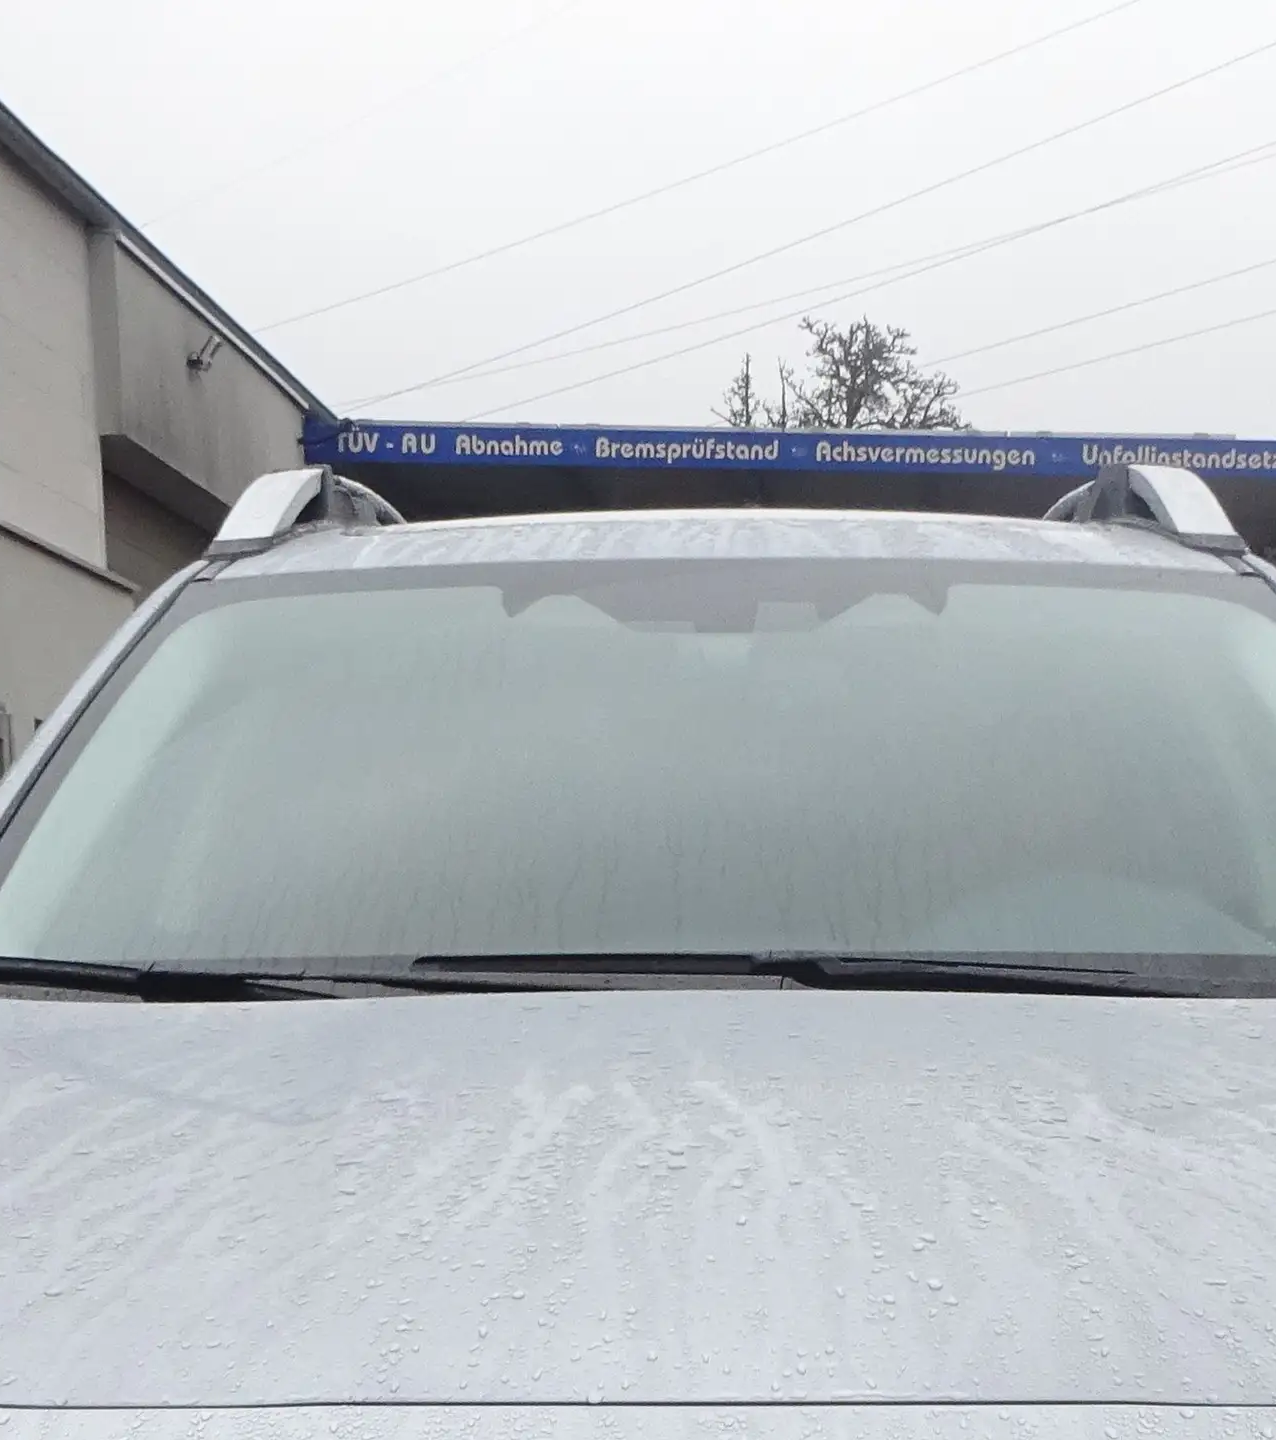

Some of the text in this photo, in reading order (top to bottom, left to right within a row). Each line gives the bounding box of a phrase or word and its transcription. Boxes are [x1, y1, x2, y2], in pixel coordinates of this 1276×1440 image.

[337, 426, 380, 454] TÜV
[402, 432, 436, 455] AU
[455, 434, 564, 456] Abnahme
[595, 436, 779, 464] Bremsprüfstand
[816, 440, 1036, 470] Achsvermessungen
